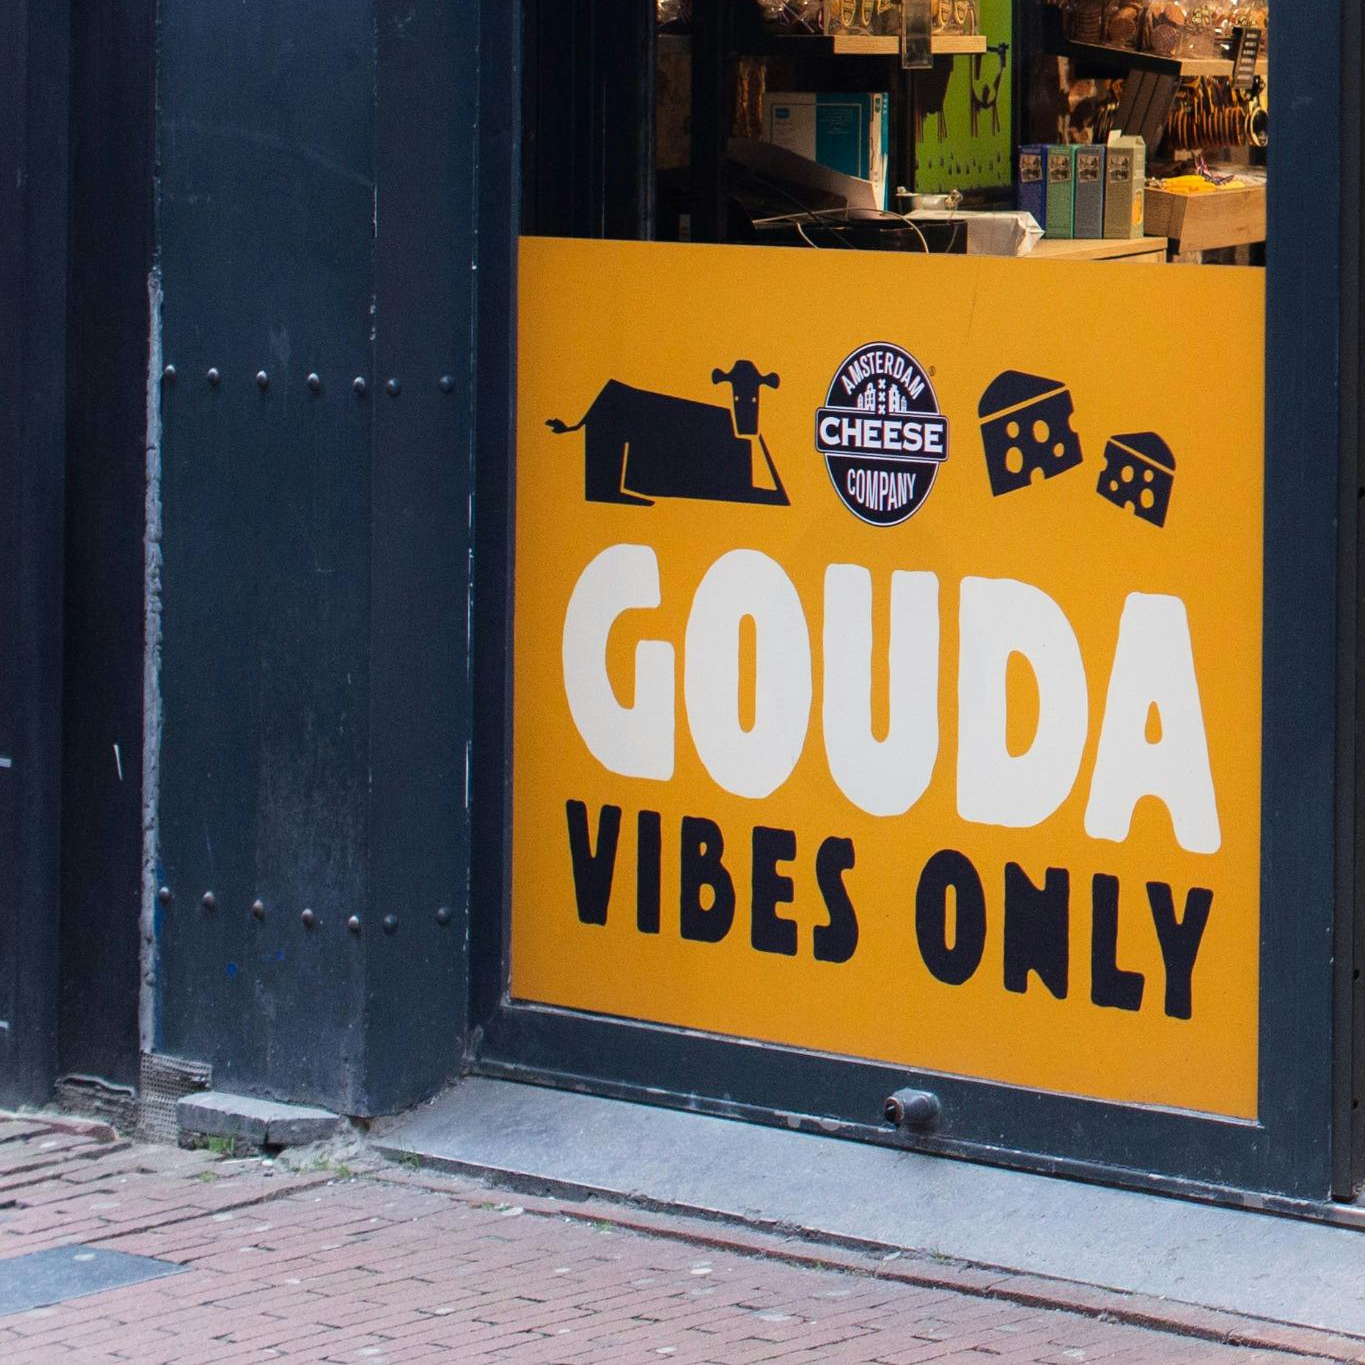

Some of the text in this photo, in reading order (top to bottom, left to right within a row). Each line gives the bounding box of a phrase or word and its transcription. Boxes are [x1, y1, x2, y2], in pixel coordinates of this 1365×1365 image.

[841, 351, 926, 400] AMSTERDAM
[819, 416, 944, 454] CHEESE
[847, 468, 917, 512] COMPANY
[562, 543, 1222, 855] GOUDA
[566, 799, 1214, 1020] VIBES ONLY
